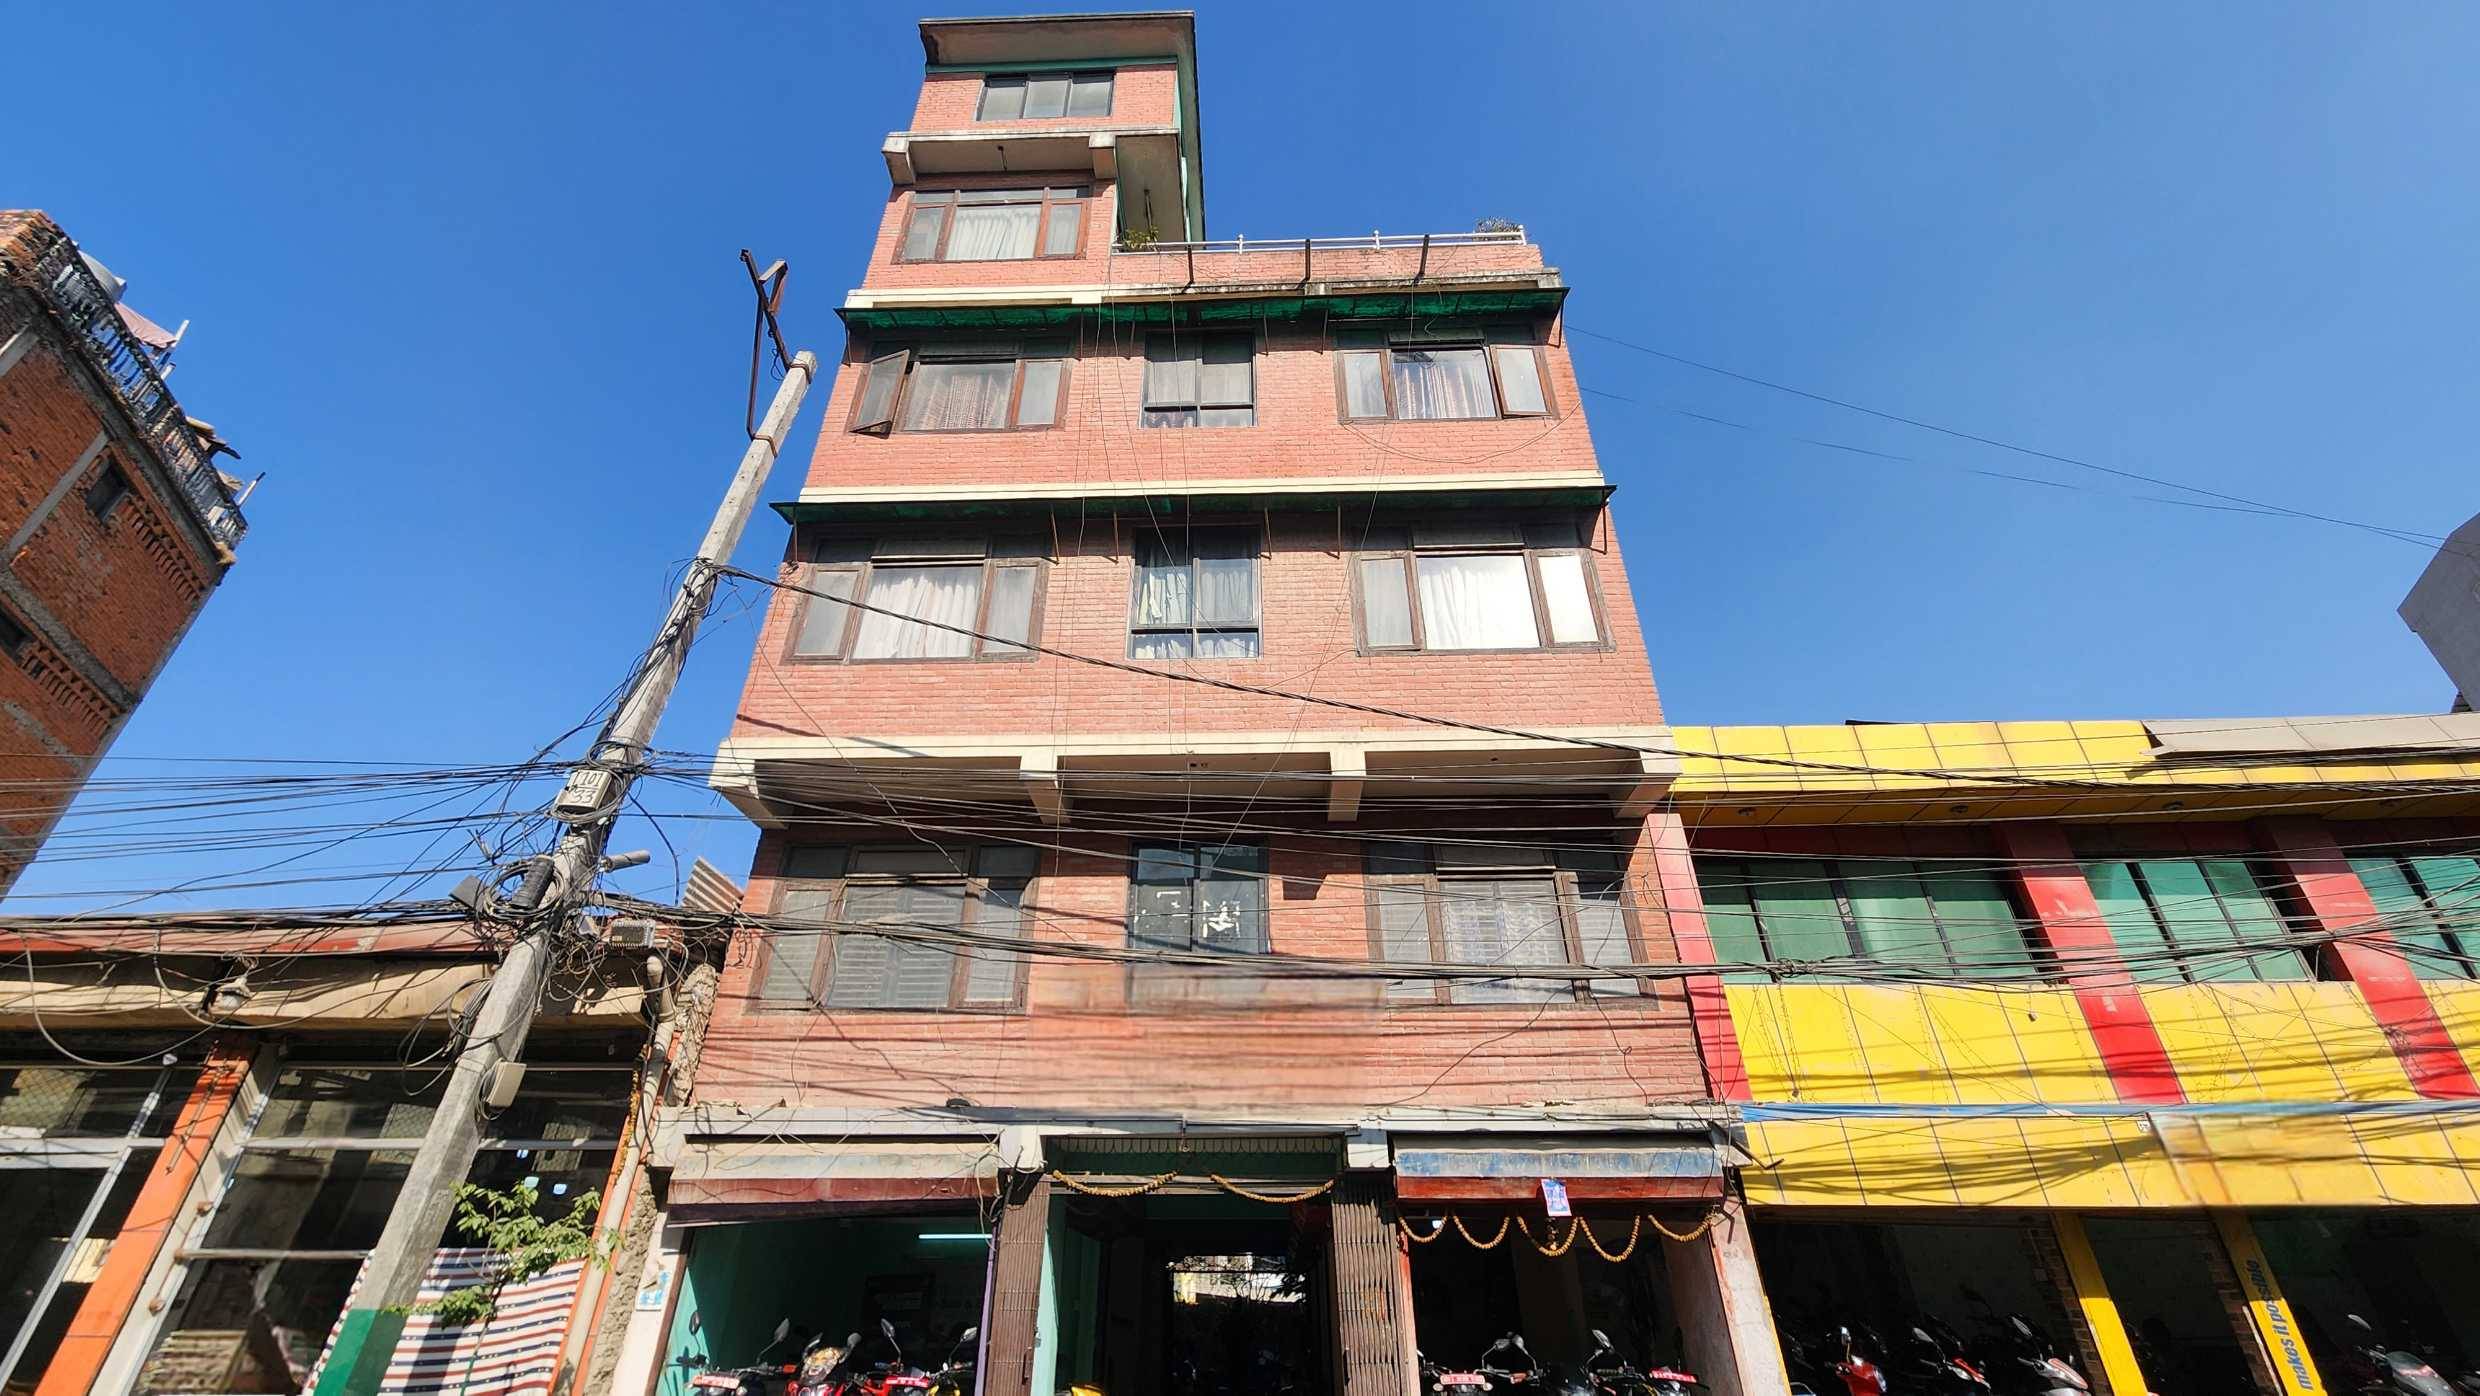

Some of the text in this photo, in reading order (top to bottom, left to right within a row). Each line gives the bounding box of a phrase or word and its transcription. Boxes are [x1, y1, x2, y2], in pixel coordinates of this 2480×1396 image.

[2246, 1259, 2314, 1390] makes it possible
